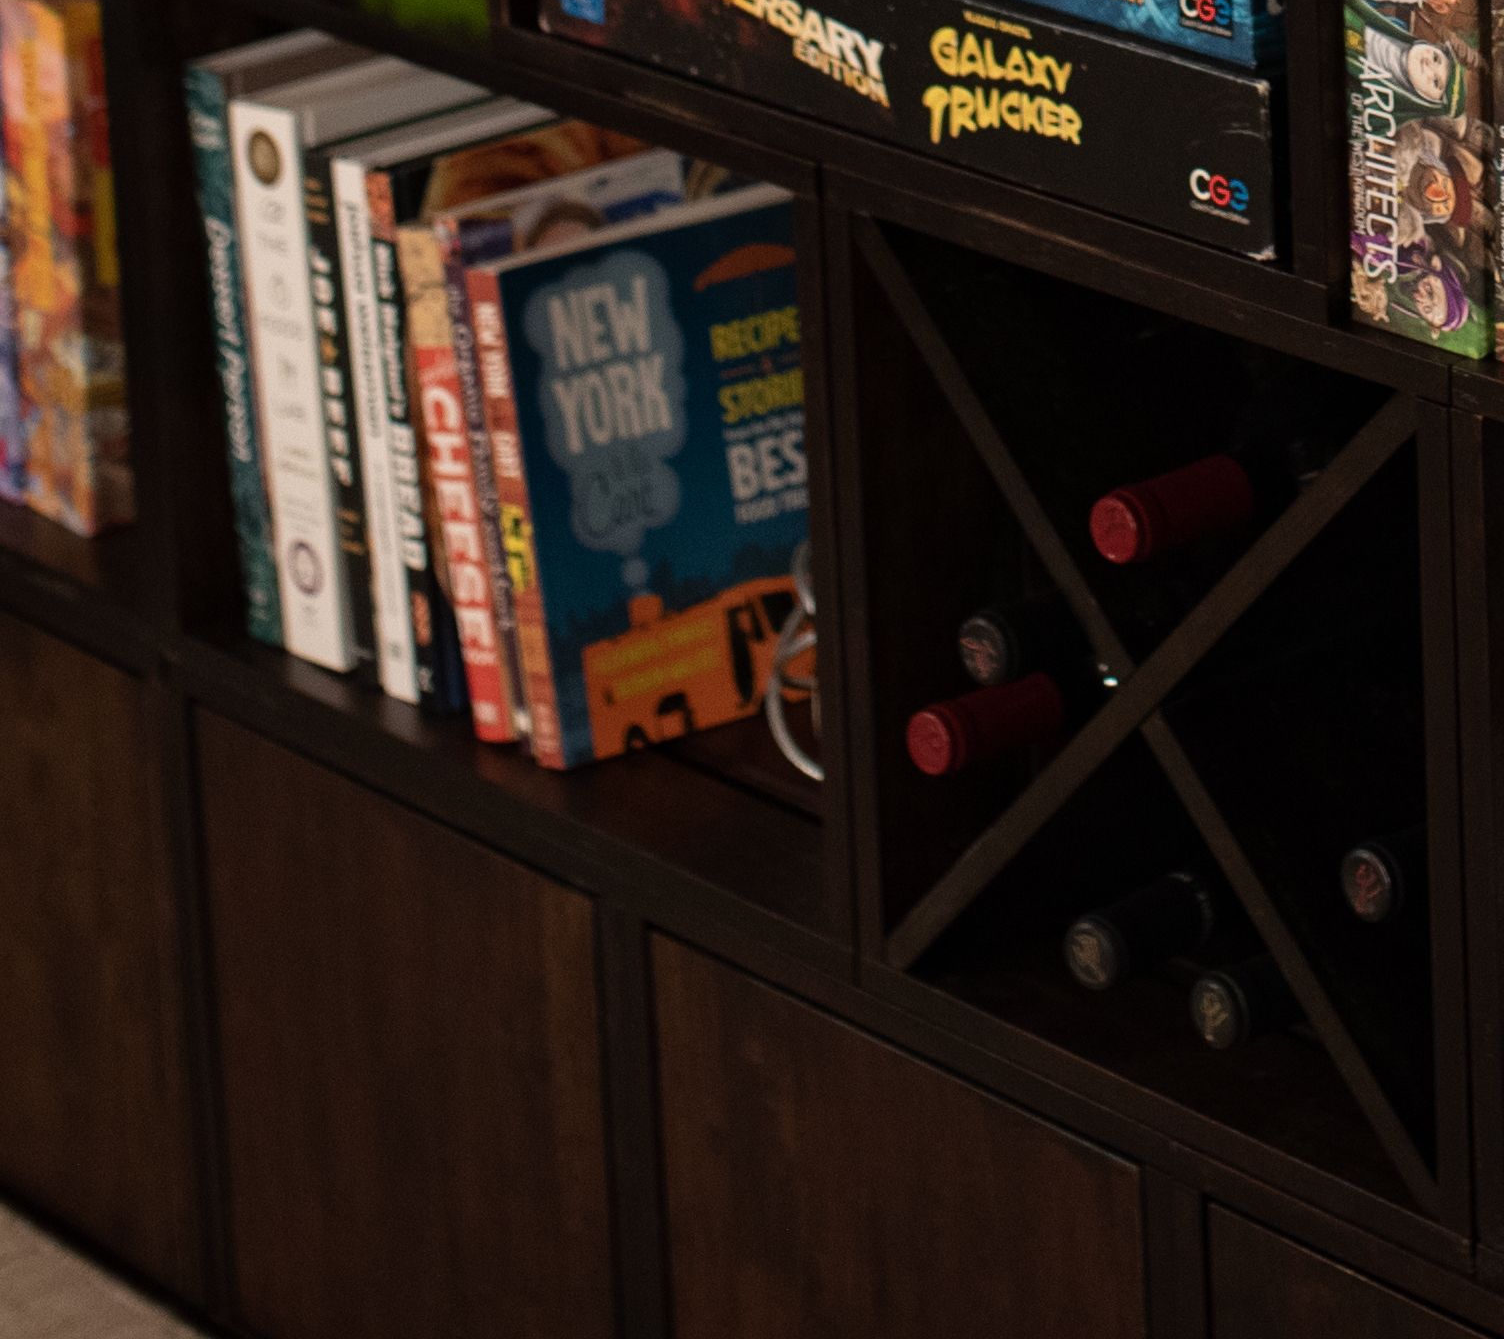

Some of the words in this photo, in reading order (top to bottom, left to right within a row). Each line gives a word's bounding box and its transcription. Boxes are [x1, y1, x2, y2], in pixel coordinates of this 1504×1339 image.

[929, 26, 1073, 95] GALAXY
[922, 84, 1084, 146] TRUCKER
[1351, 176, 1366, 236] KINGDOM
[1357, 56, 1398, 284] ARCHITECTS
[309, 244, 340, 337] JOE
[547, 273, 651, 371] NEW
[220, 347, 254, 463] Person
[324, 368, 354, 488] BEEF
[551, 352, 673, 455] YORK
[388, 423, 427, 571] BREAD
[725, 428, 810, 502] BES
